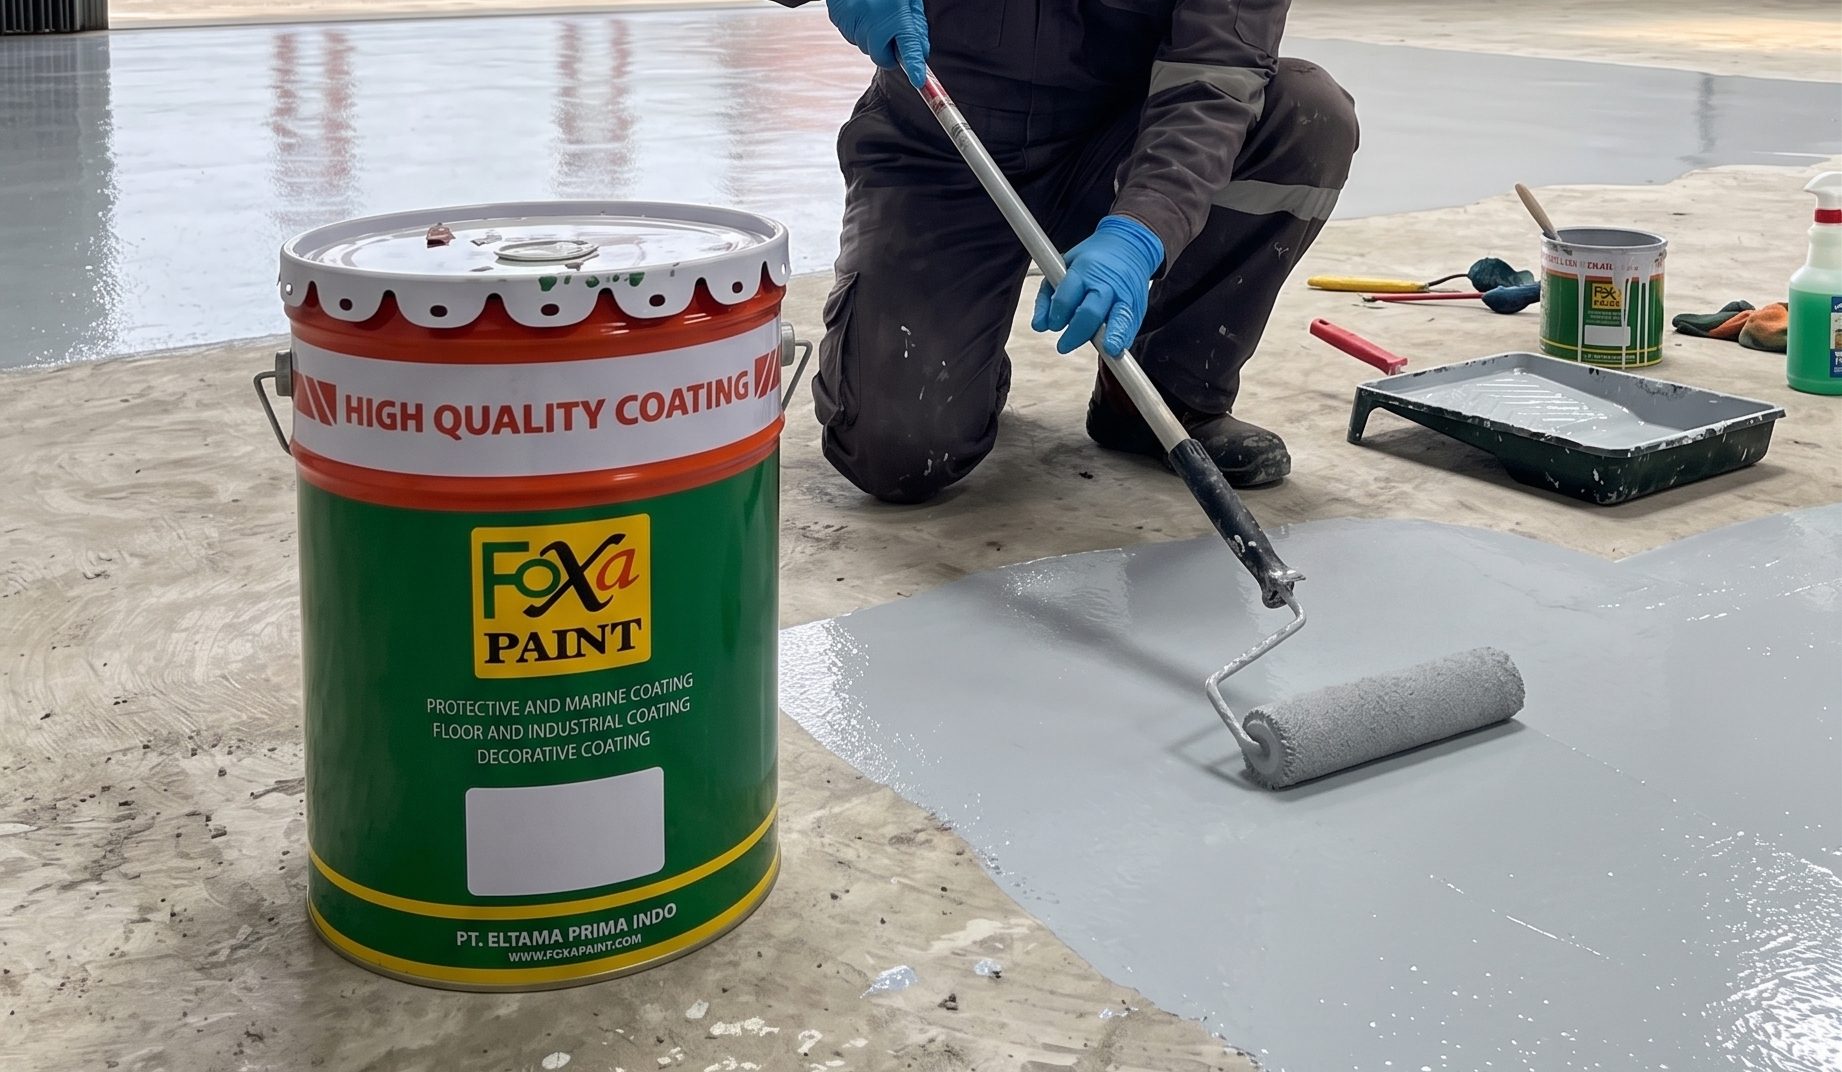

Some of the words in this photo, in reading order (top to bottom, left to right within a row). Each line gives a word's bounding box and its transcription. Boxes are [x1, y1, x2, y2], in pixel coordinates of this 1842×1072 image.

[345, 394, 424, 433] HIGH
[433, 398, 607, 441] QUALITY
[615, 370, 749, 426] COATING
[484, 618, 642, 664] PAINT
[427, 698, 520, 716] PROTECTIVE
[524, 698, 561, 715] AND
[565, 688, 626, 712] MARINE
[630, 672, 694, 702] COATING
[433, 723, 483, 740] FLOOR
[488, 725, 524, 740] AND
[528, 714, 623, 739] INDUSTRIAL
[626, 696, 690, 726] COATING
[477, 744, 577, 764] DECORATIVE
[581, 730, 651, 757] COATING
[457, 930, 483, 947] PT.
[488, 928, 564, 948] ELTAMA
[568, 917, 628, 942] PRIMA
[633, 902, 677, 930] INDO
